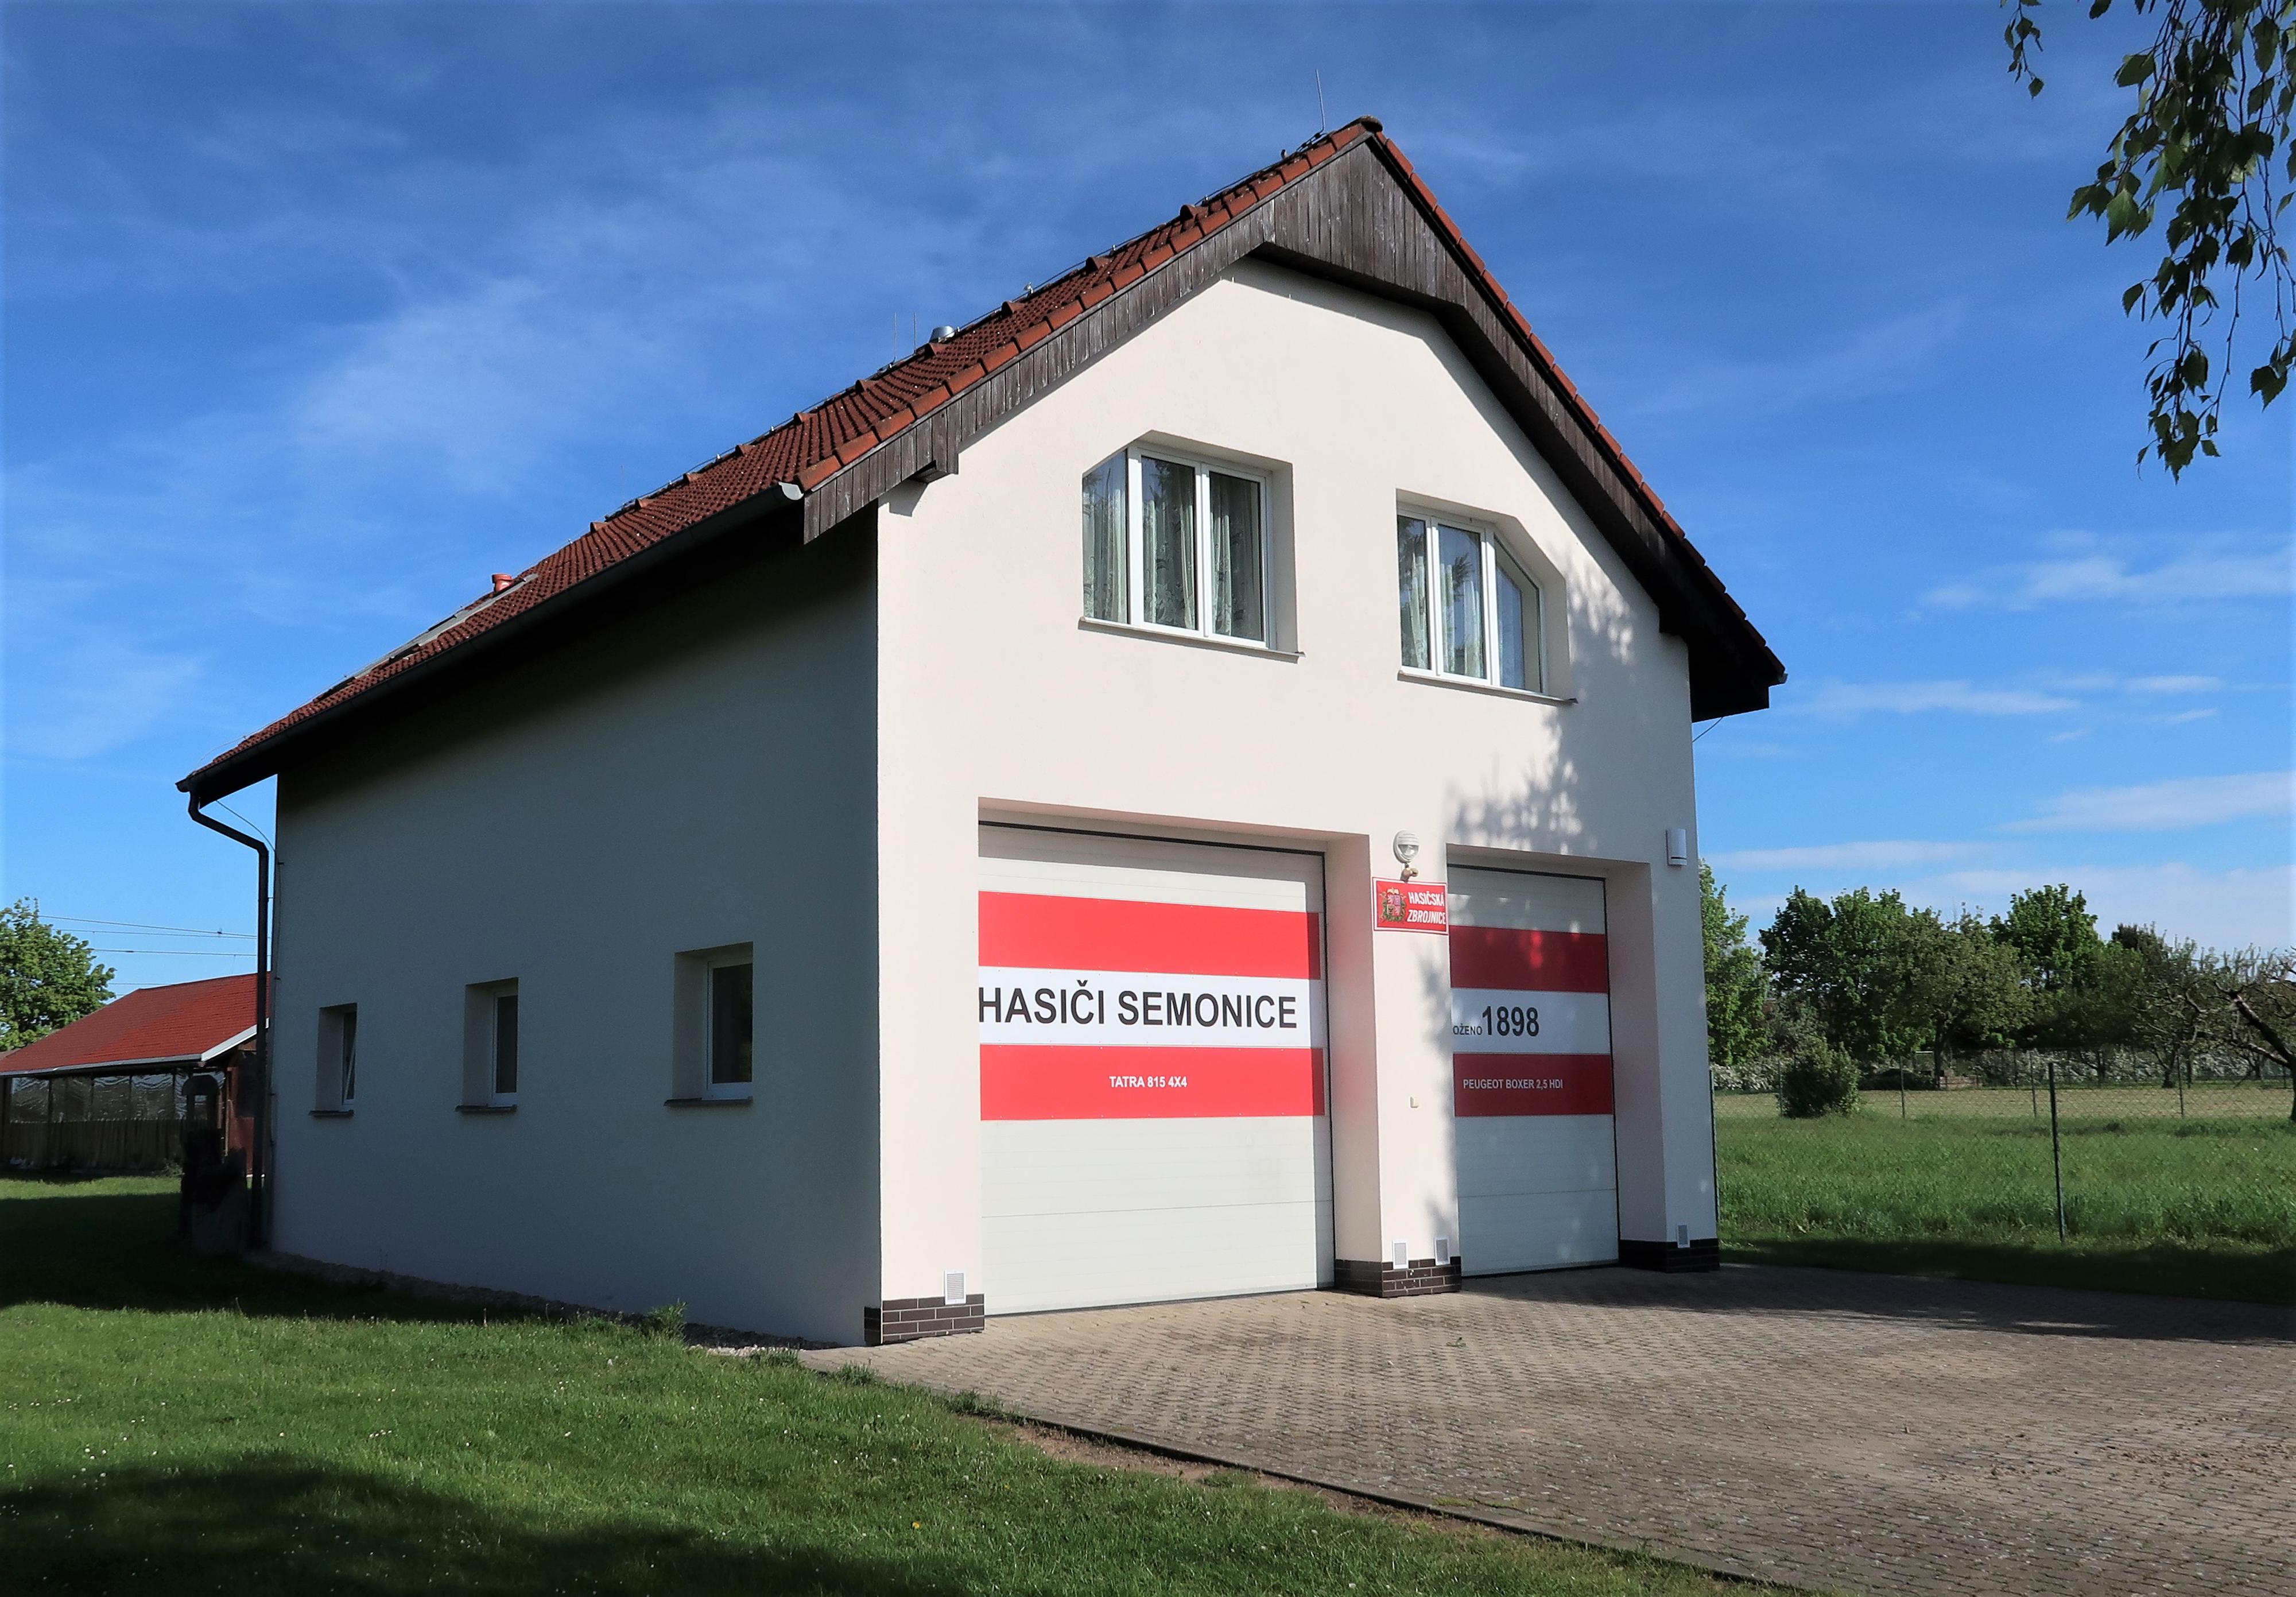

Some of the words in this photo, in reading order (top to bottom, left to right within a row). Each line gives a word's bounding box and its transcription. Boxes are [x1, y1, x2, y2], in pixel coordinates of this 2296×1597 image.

[1408, 890, 1445, 906] HASIČSKÁ
[1406, 909, 1446, 924] ZBROJNICE
[979, 979, 1104, 1025] HASIČI
[1118, 990, 1297, 1029] SEMONICE
[1482, 1005, 1539, 1037] 1898
[1109, 1076, 1145, 1088] TATRA
[1147, 1076, 1166, 1088] 815
[1168, 1076, 1188, 1088] 4X4
[1463, 1079, 1504, 1089] PEUGEOT
[1506, 1079, 1534, 1089] BOXER
[1536, 1079, 1548, 1090] 2,5
[1549, 1079, 1563, 1088] HDI
